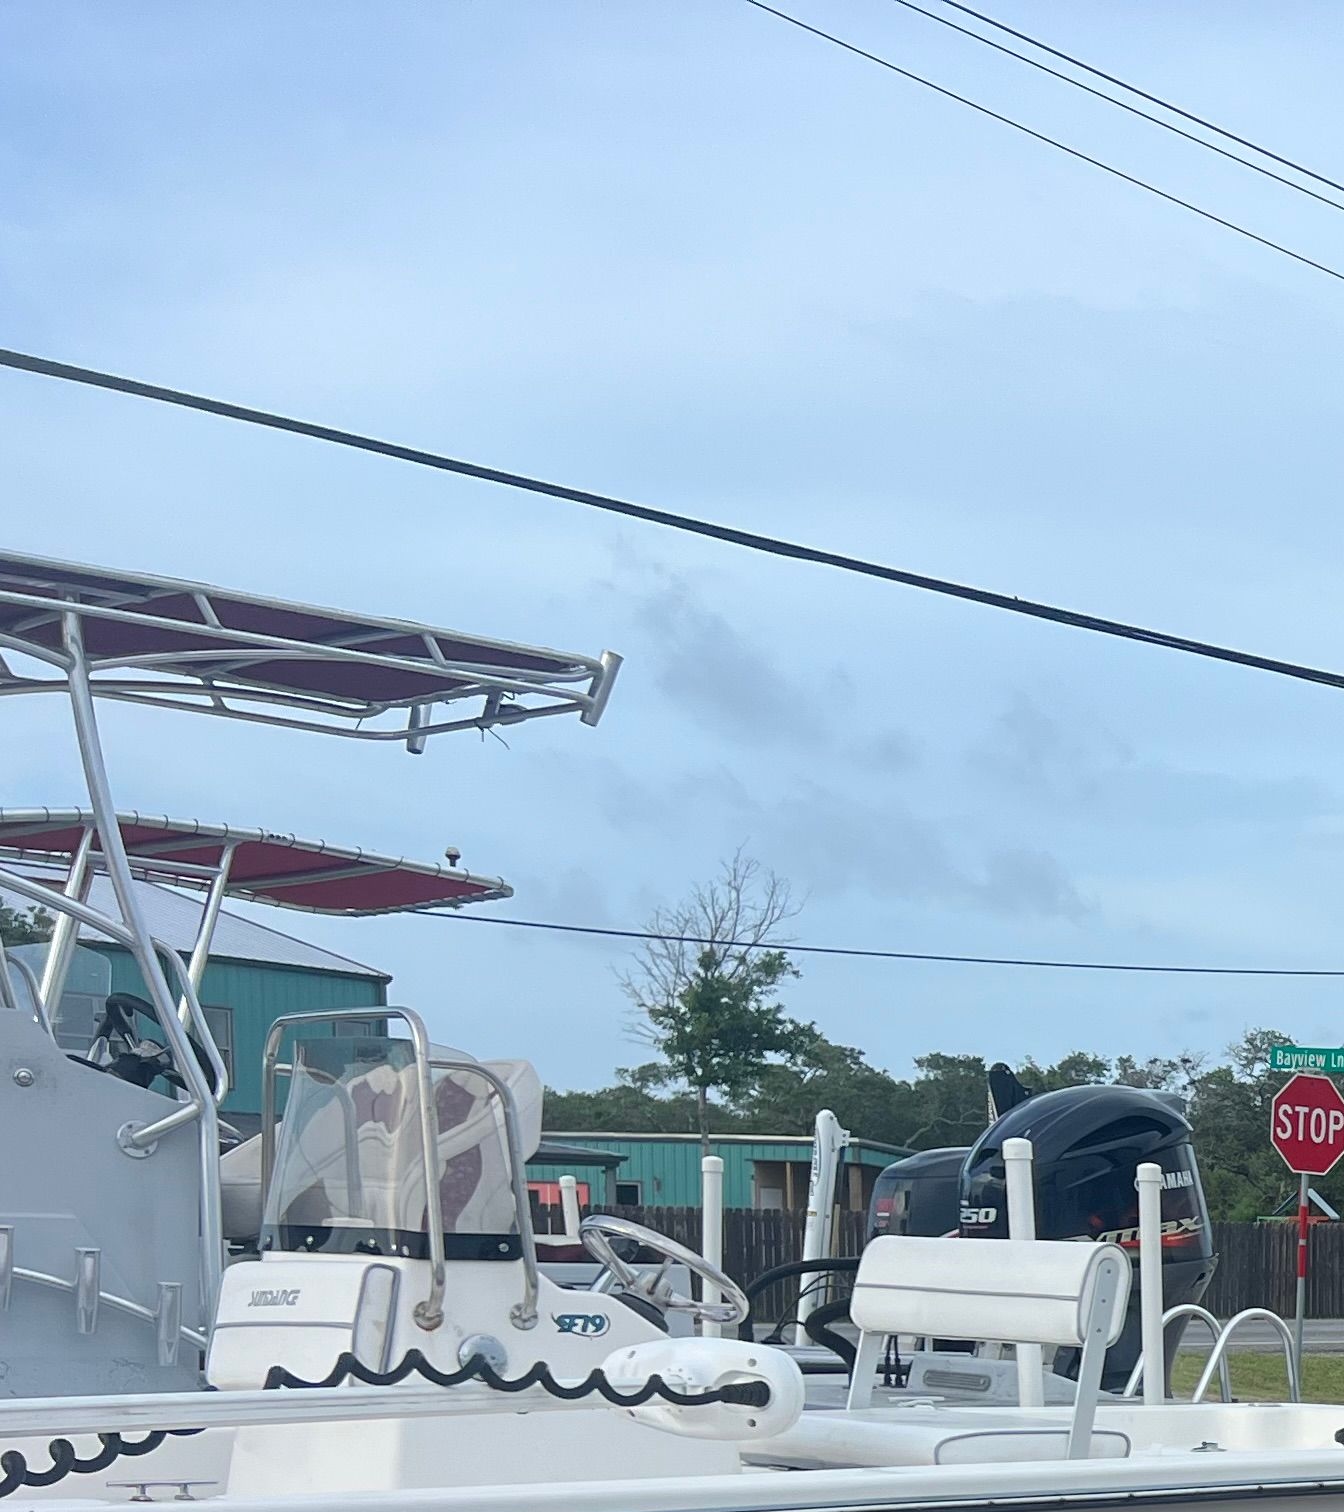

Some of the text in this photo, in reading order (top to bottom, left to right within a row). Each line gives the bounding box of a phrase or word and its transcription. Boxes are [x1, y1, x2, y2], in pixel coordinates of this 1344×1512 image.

[1277, 1050, 1344, 1069] Bayview Ln
[1275, 1104, 1344, 1145] STOP
[1160, 1170, 1194, 1189] AMAHA
